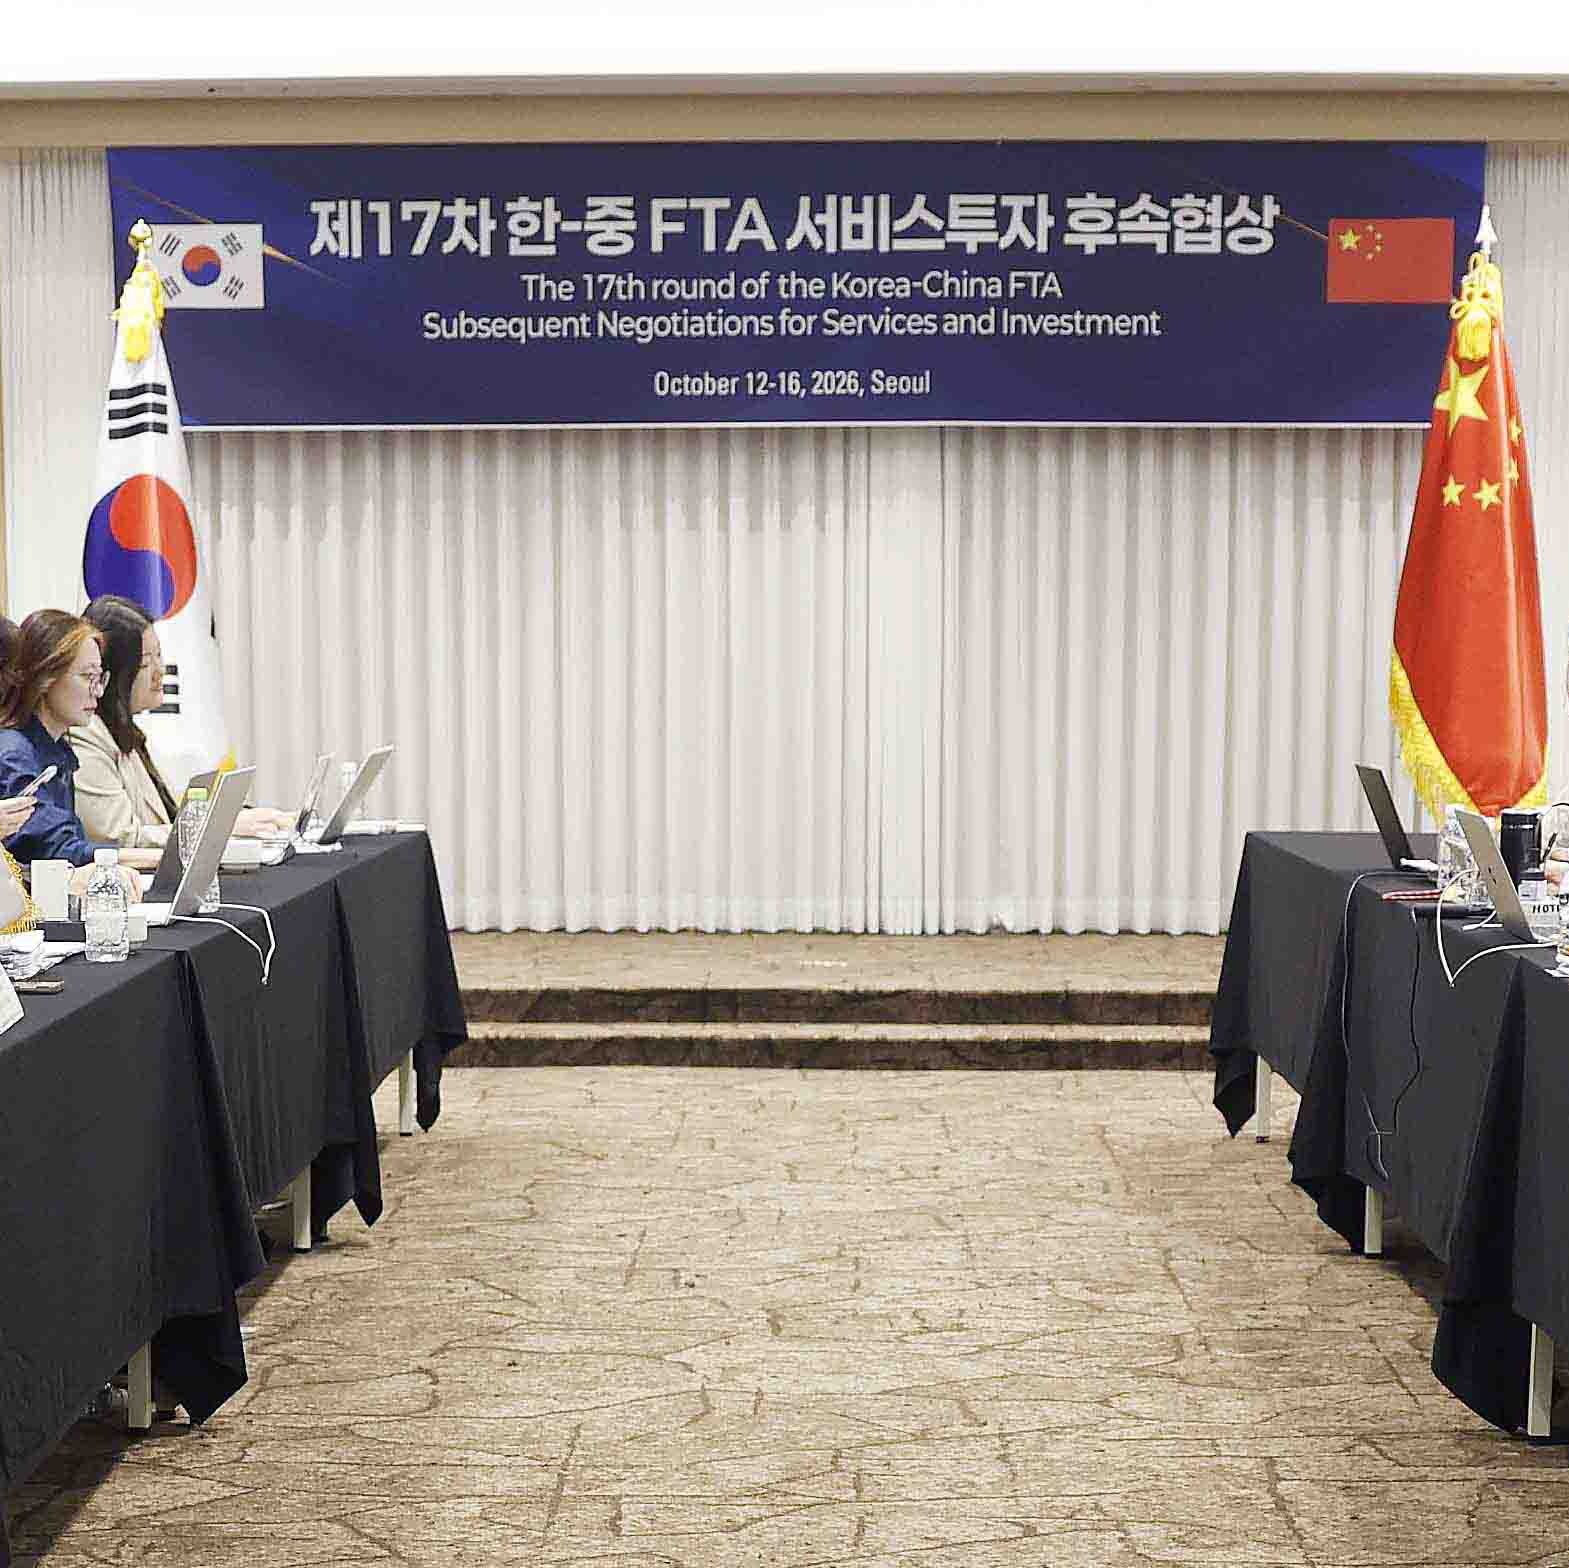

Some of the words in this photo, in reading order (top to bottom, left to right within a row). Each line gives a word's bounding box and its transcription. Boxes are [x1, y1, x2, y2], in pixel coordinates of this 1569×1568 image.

[309, 197, 497, 258] 제17차
[650, 197, 778, 254] FTA
[785, 193, 1055, 255] 서비스투자
[1063, 192, 1281, 256] 후속협상
[520, 273, 575, 301] The
[582, 272, 645, 301] 17th
[651, 271, 735, 300] round
[741, 270, 771, 299] of
[777, 270, 826, 299] the
[831, 269, 1002, 299] Korea-China
[1009, 271, 1063, 299] FTA
[423, 310, 592, 345] Subsequent
[597, 308, 775, 344] Negotiations
[778, 307, 818, 336] for
[822, 306, 938, 336] Services
[942, 306, 995, 335] and
[1002, 307, 1162, 336] Investment
[654, 370, 740, 396] October
[745, 370, 807, 399] 12-16,
[811, 370, 865, 398] 2026,
[870, 369, 930, 395] Seoul
